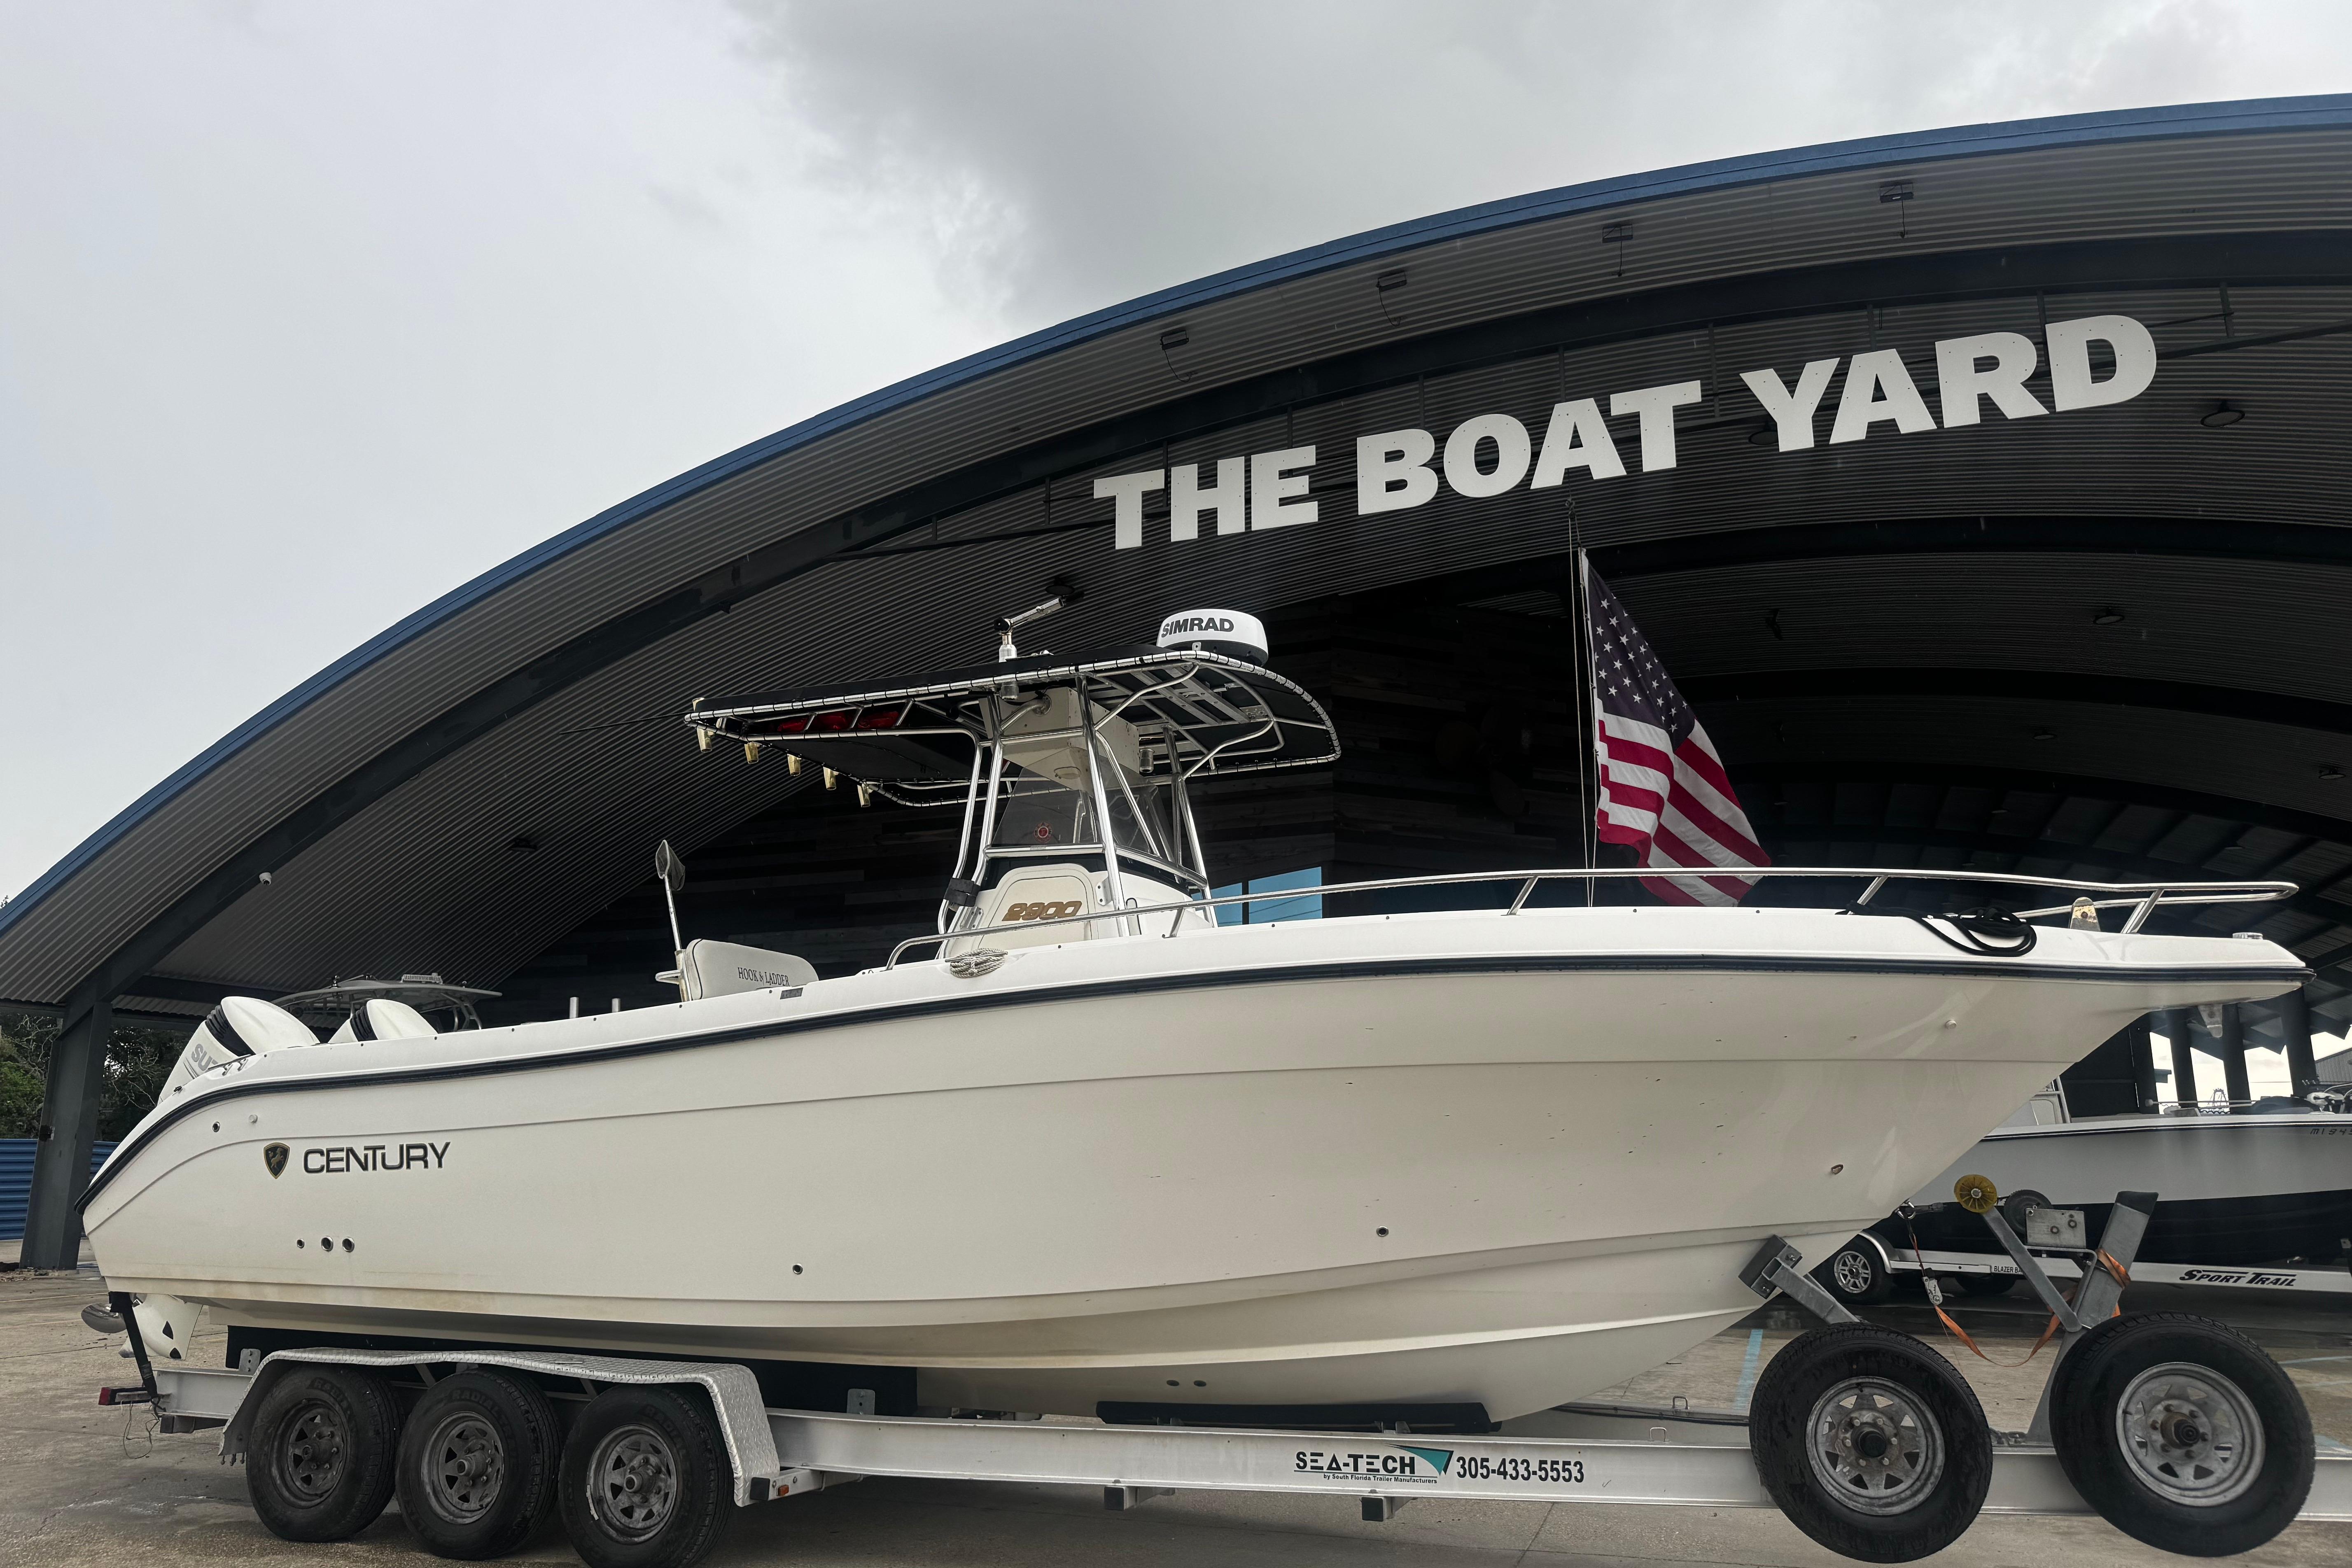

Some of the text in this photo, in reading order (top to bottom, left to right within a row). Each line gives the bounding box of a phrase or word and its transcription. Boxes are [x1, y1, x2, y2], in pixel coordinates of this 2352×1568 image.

[1093, 315, 2157, 550] THE BOAT YARD
[1161, 617, 1234, 638] SIMRAD
[1002, 901, 1083, 922] 2900
[737, 967, 790, 987] HOOK & LADDER
[303, 1141, 451, 1174] CENTURY
[2179, 1269, 2297, 1286] SPORT TRAIL
[452, 1389, 499, 1416] RADIAL
[1295, 1451, 1416, 1475] SEA-TECH
[1456, 1456, 1584, 1483] 305-433-5553
